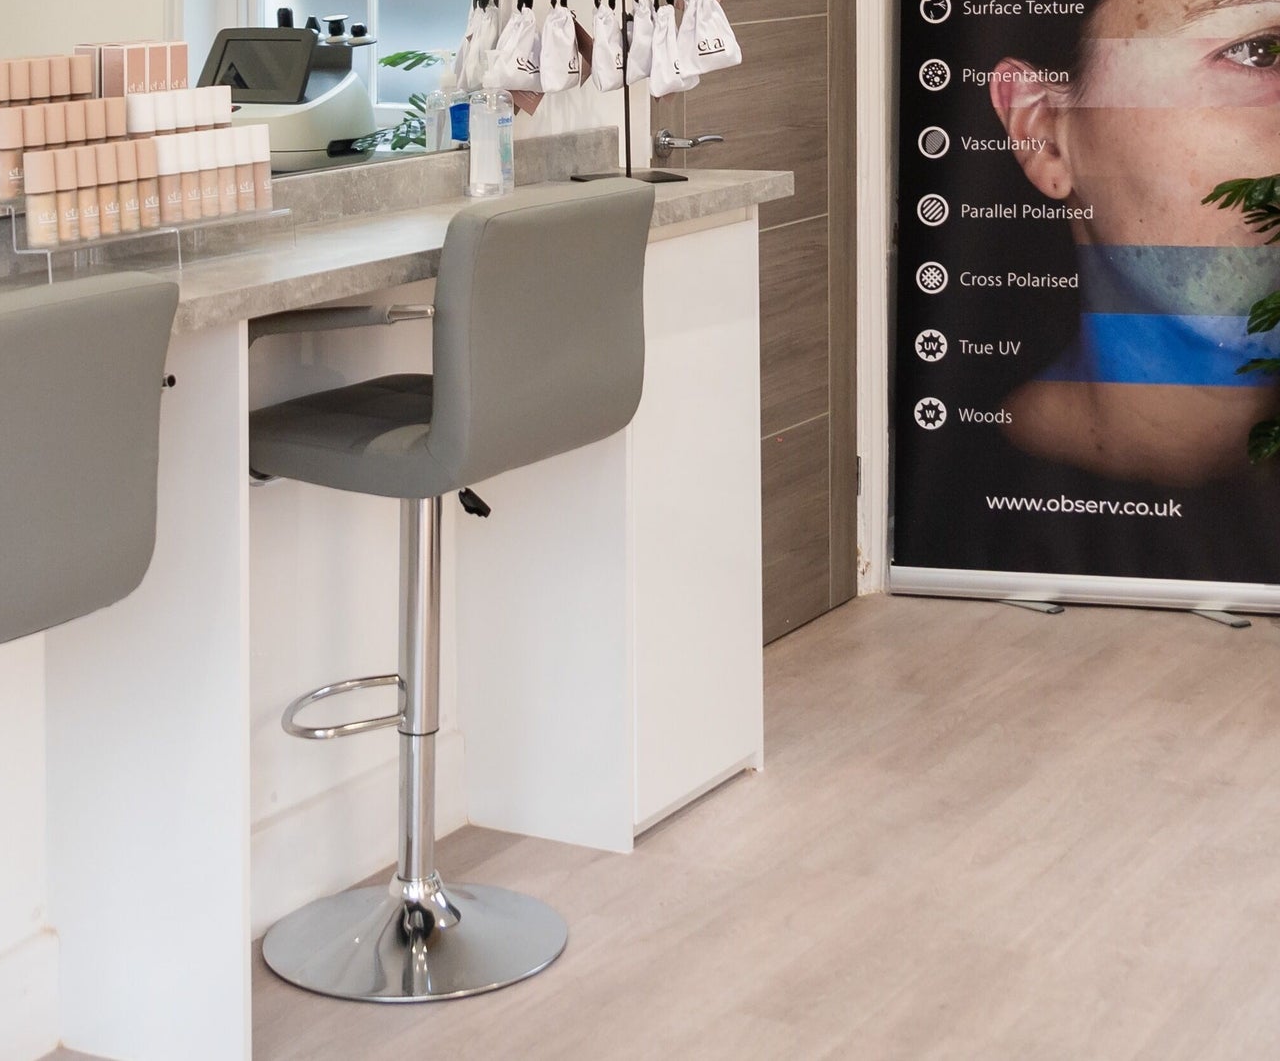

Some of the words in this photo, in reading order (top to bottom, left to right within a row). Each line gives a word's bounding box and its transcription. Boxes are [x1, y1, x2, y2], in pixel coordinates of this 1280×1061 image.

[962, 0, 1022, 15] Surface
[1025, 0, 1085, 15] Texture
[961, 68, 1069, 87] Pigmentation
[960, 135, 1047, 154] Vascularity
[960, 203, 1017, 219] Parallel
[1022, 203, 1094, 220] Polarised
[959, 271, 1003, 287] Cross
[1007, 272, 1079, 288] Polarised
[959, 339, 994, 355] True
[998, 339, 1021, 355] UV
[958, 407, 1013, 425] Woods
[985, 494, 1183, 518] www.observ.co.uk
